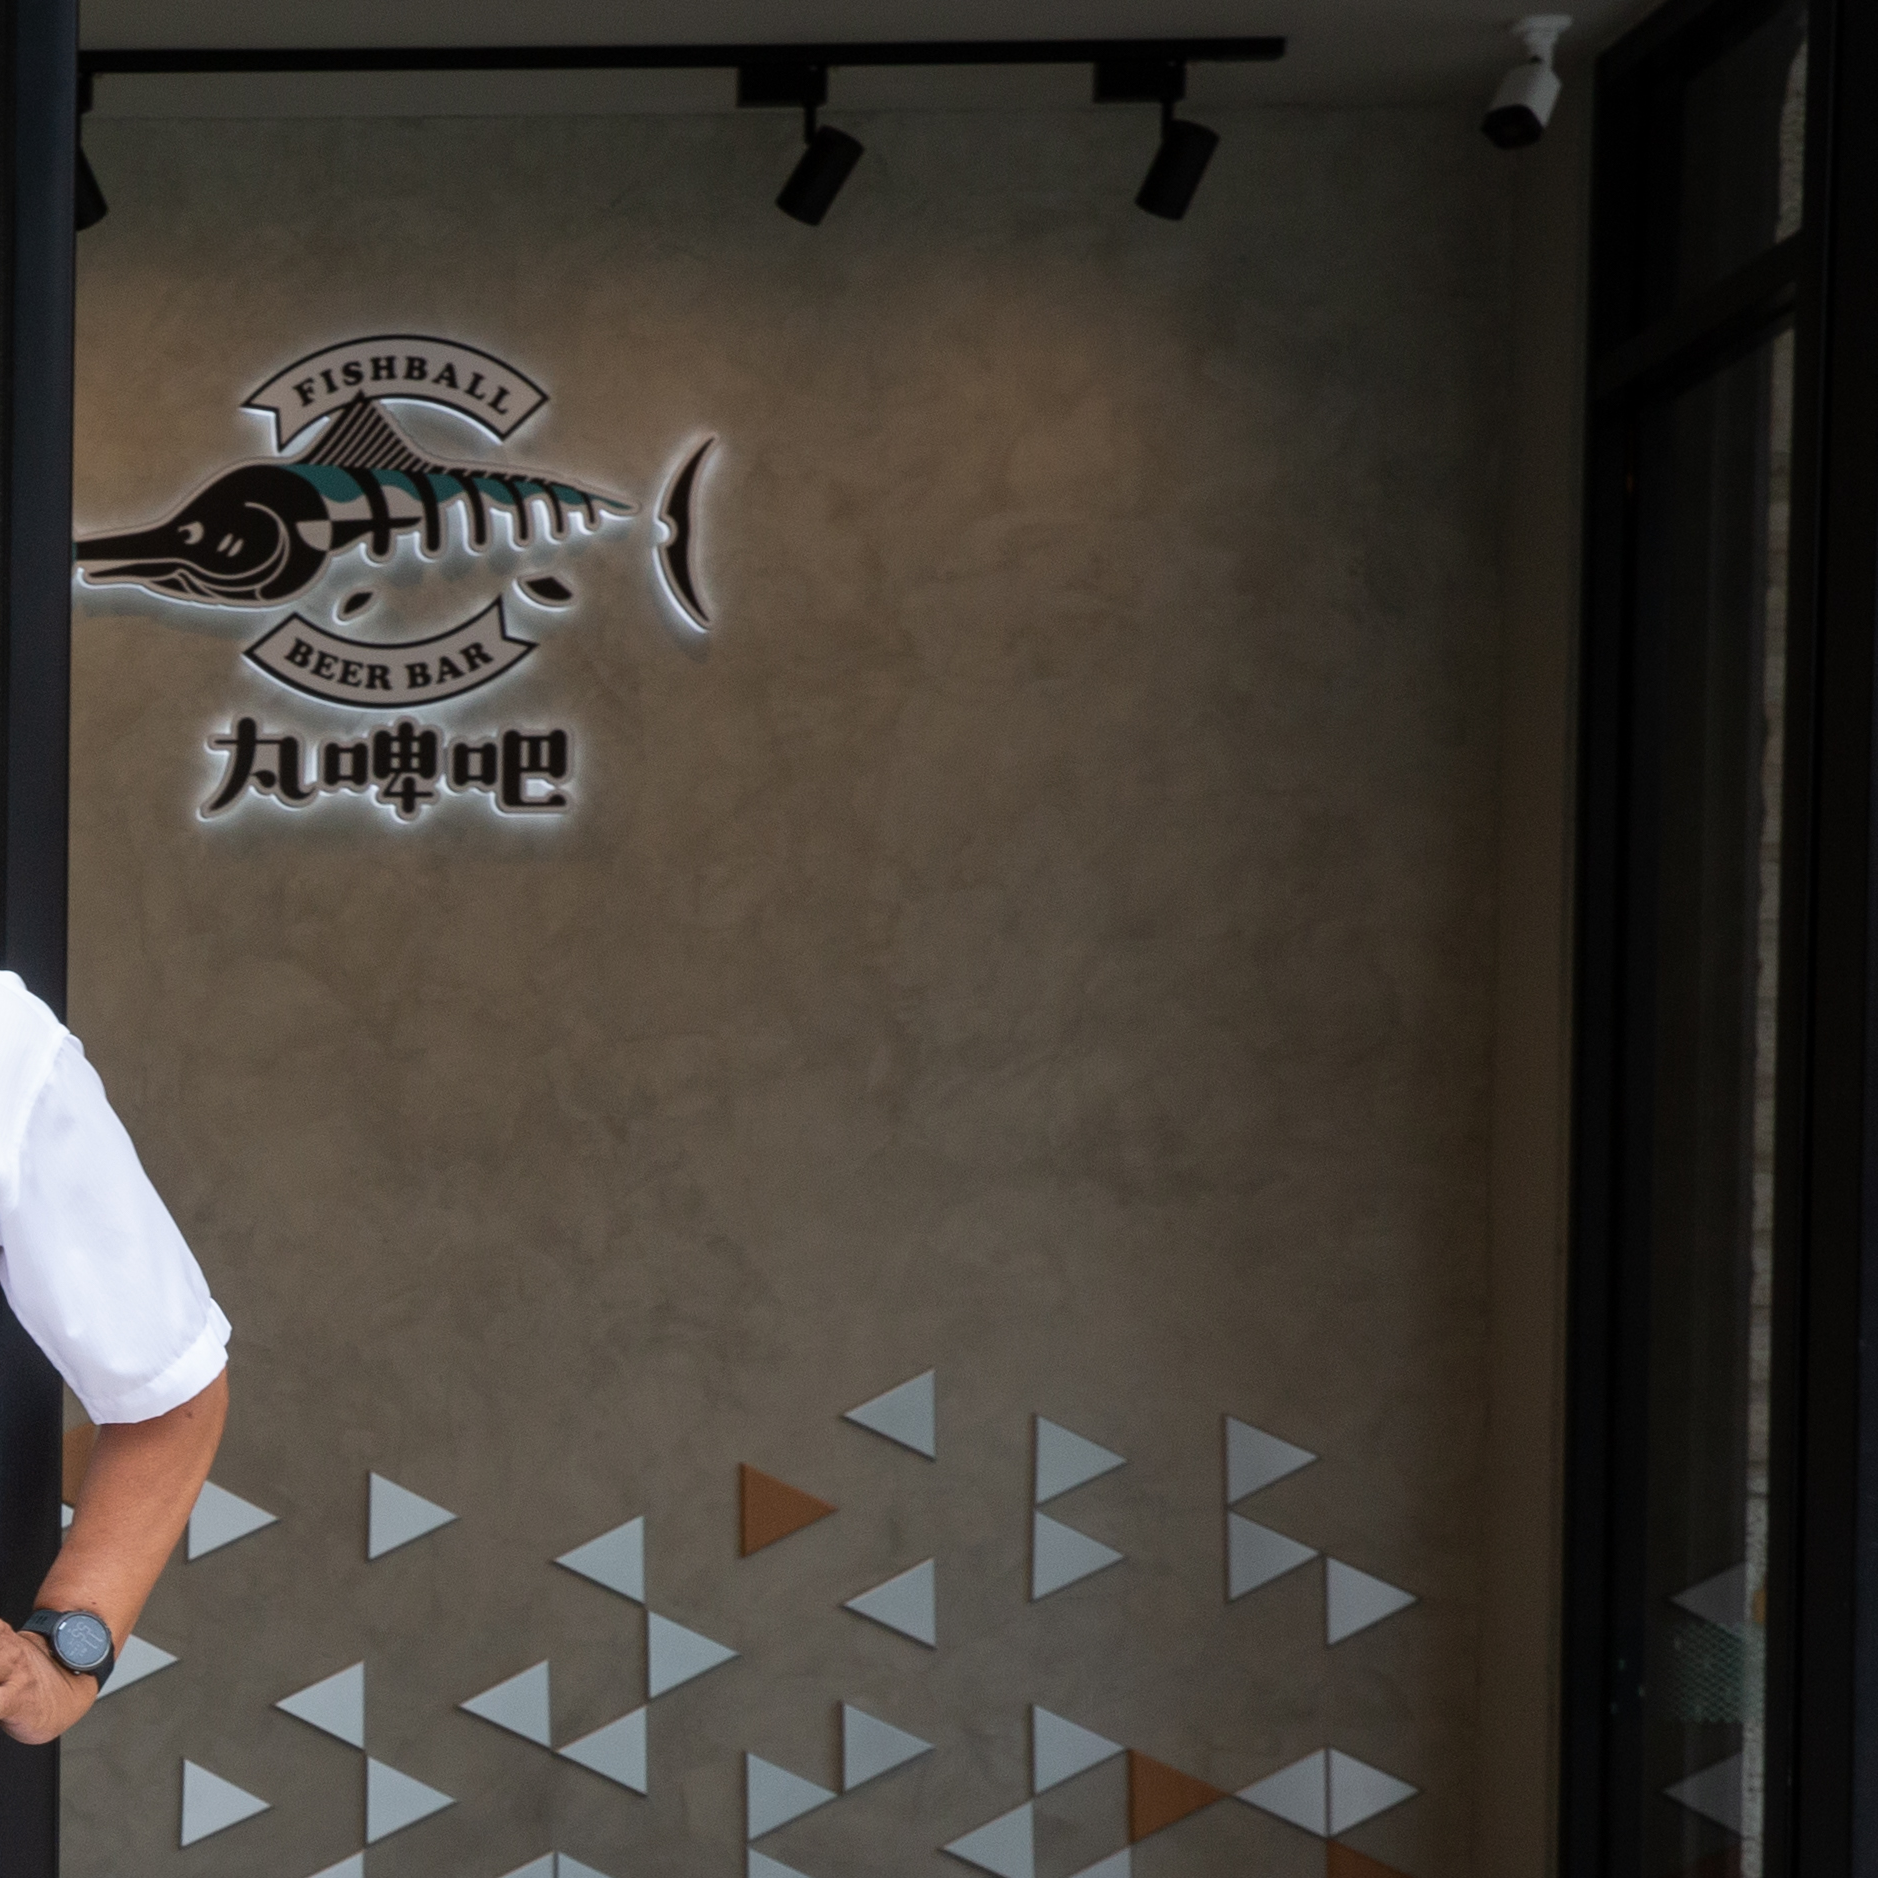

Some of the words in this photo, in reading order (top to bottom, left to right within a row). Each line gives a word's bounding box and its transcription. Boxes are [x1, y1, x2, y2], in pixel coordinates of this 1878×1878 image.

[292, 354, 511, 416] FISHBALL
[284, 636, 392, 692] BEER
[405, 639, 495, 690] BAR
[203, 715, 569, 816] 丸啤吧
